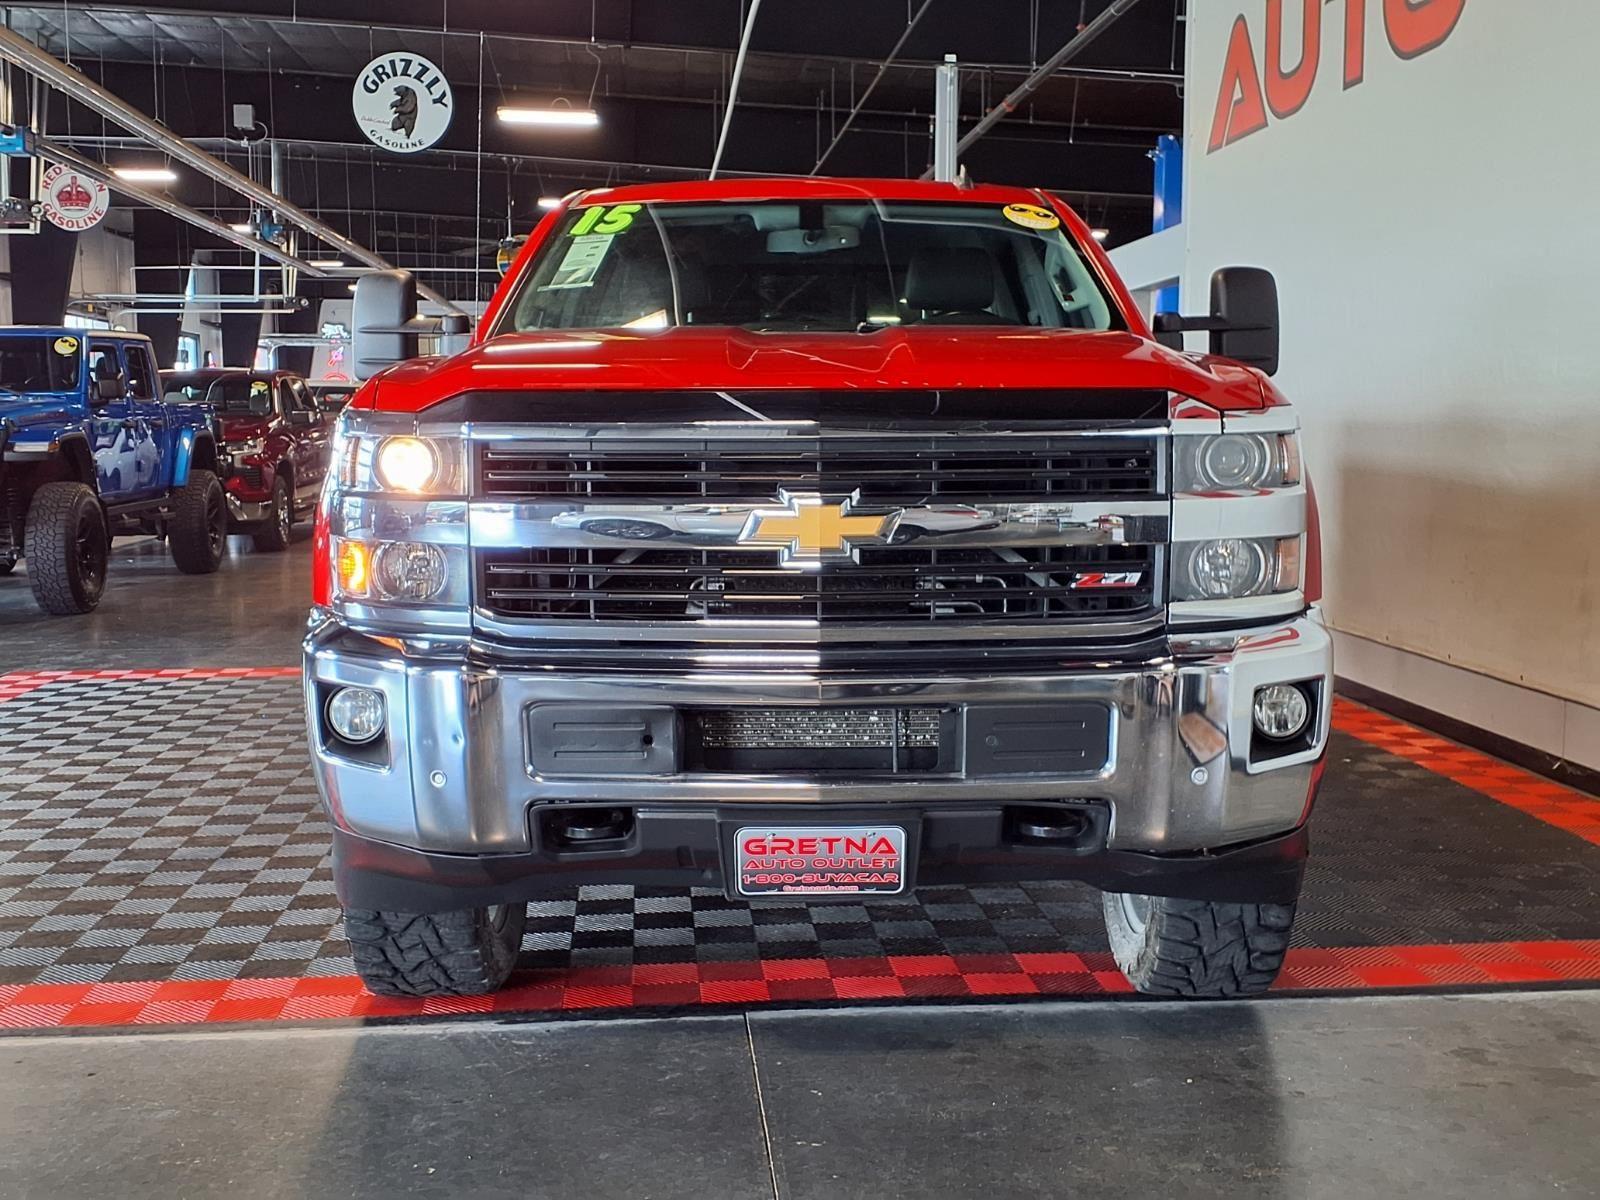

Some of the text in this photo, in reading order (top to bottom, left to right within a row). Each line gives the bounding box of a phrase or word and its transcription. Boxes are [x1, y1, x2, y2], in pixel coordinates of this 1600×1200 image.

[362, 58, 448, 108] GRIZZLY
[370, 129, 425, 149] GASOLINE
[42, 166, 63, 190] RED
[43, 203, 104, 228] GASOLINE
[570, 204, 642, 236] 15
[1070, 572, 1142, 588] Z71
[743, 837, 898, 856] GRETNA
[743, 857, 899, 870] AUTO OUTLET
[743, 873, 899, 884] 1-800-BUYACAR
